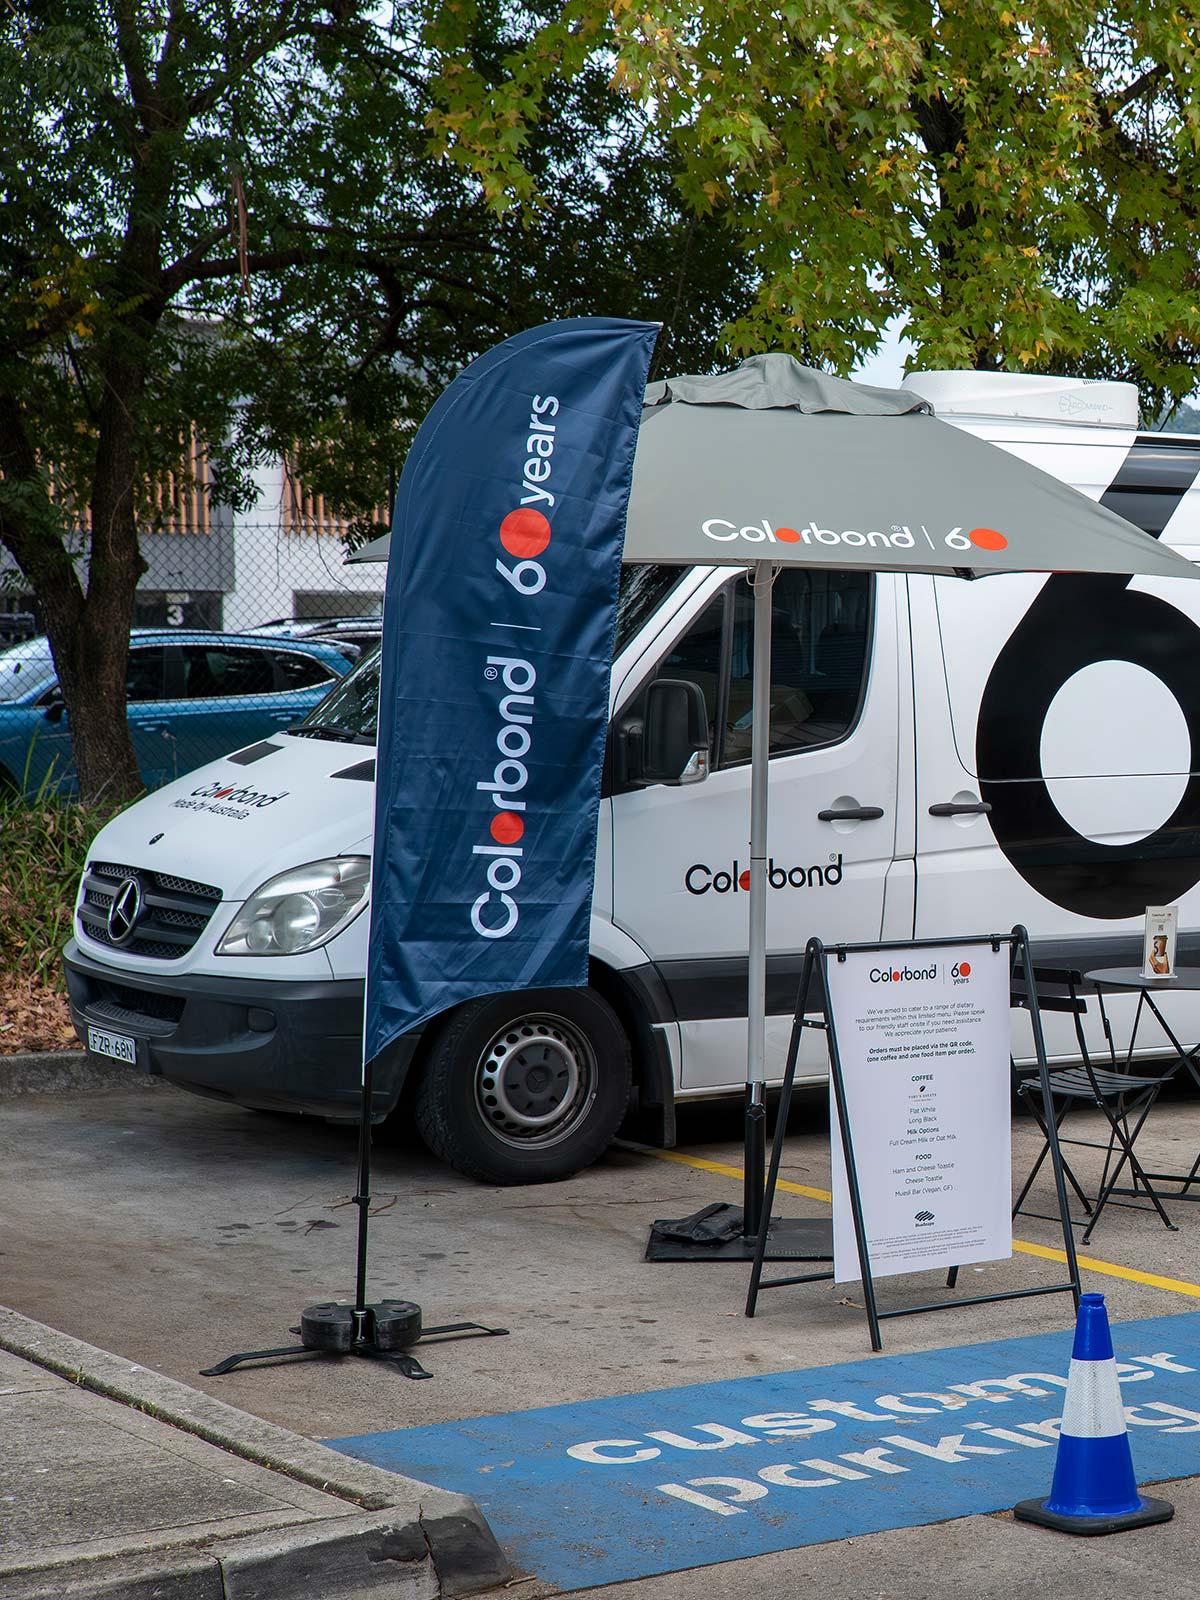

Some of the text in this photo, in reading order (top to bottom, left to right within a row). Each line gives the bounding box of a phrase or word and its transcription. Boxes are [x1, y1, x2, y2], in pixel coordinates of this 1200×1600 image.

[167, 604, 184, 626] 3
[684, 854, 843, 895] Colobond
[895, 1029, 921, 1037] appreciate
[911, 1044, 930, 1052] placed
[911, 1074, 934, 1082] COFFEE
[908, 1115, 937, 1125] Long Black
[919, 1126, 939, 1135] Options
[889, 1139, 899, 1147] Full
[900, 1138, 917, 1146] Cream
[936, 1134, 946, 1142] Oat
[915, 1152, 932, 1161] FOOD
[893, 1167, 905, 1175] Ham
[917, 1164, 936, 1172] Cheese
[936, 1162, 955, 1170] Toastie
[904, 1177, 924, 1185] Cheese
[895, 1189, 911, 1197] Muesli
[912, 1188, 921, 1196] Bar
[943, 1183, 954, 1192] GF)
